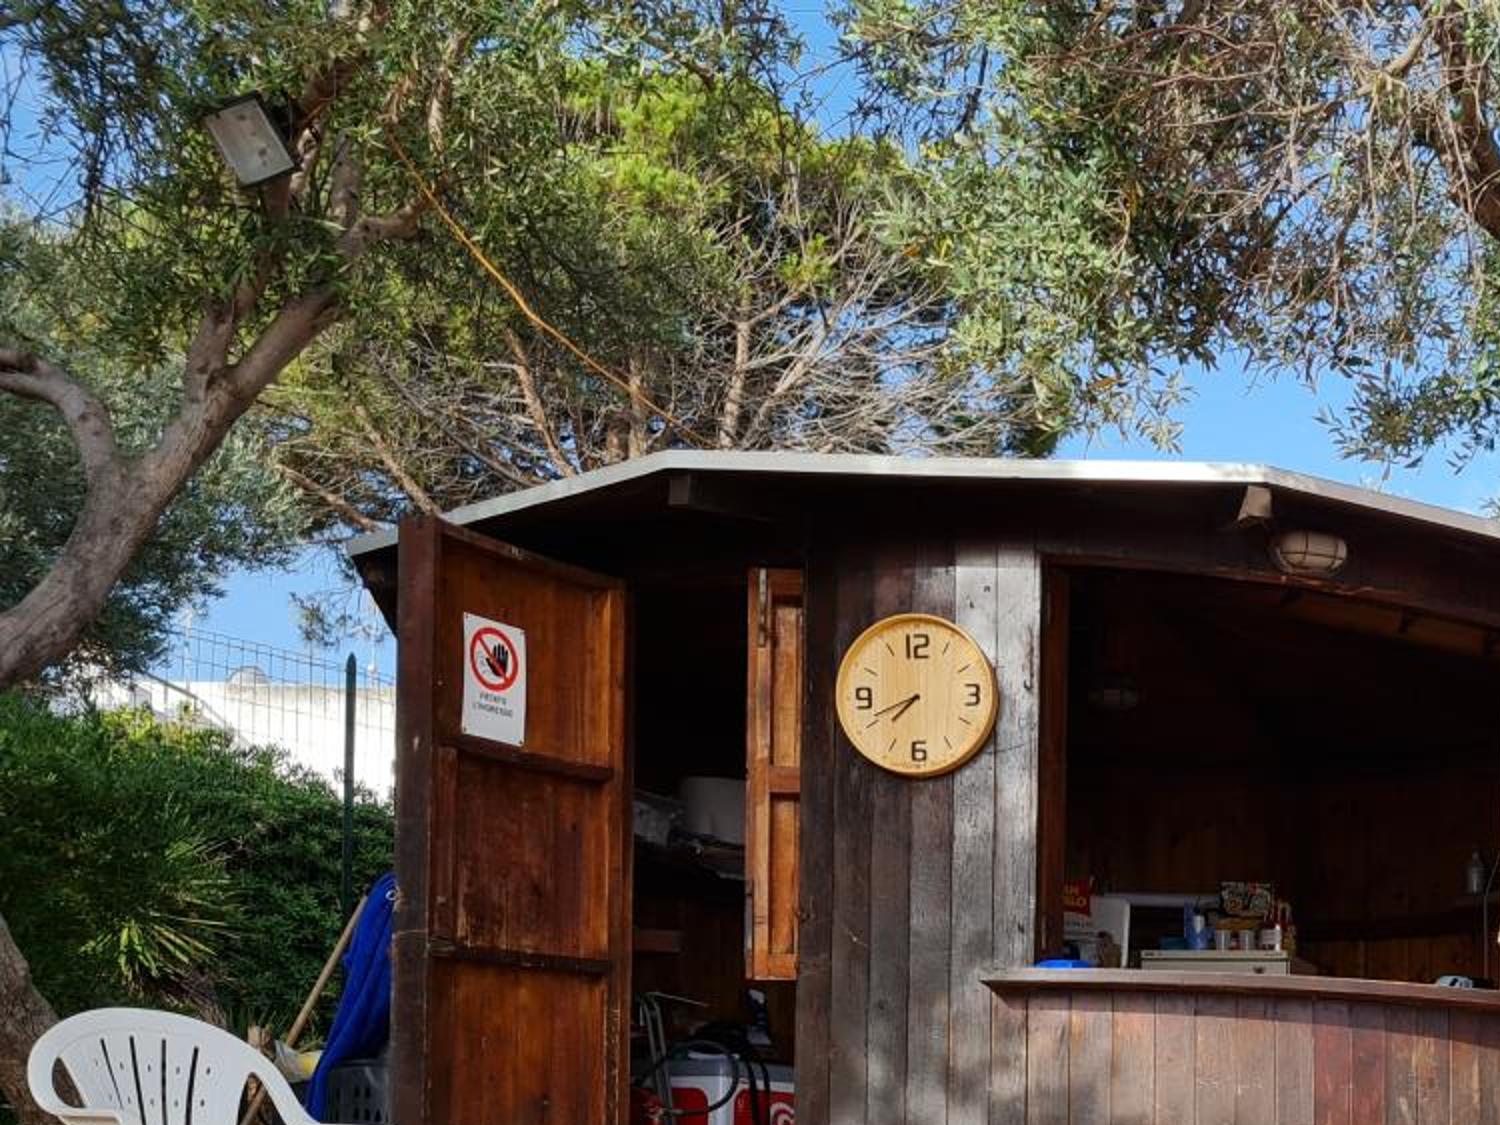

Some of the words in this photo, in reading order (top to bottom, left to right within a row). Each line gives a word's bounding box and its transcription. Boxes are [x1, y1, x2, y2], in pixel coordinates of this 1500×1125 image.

[905, 633, 930, 660] 12
[855, 687, 873, 710] 9
[964, 683, 981, 707] 3
[910, 740, 927, 762] 6
